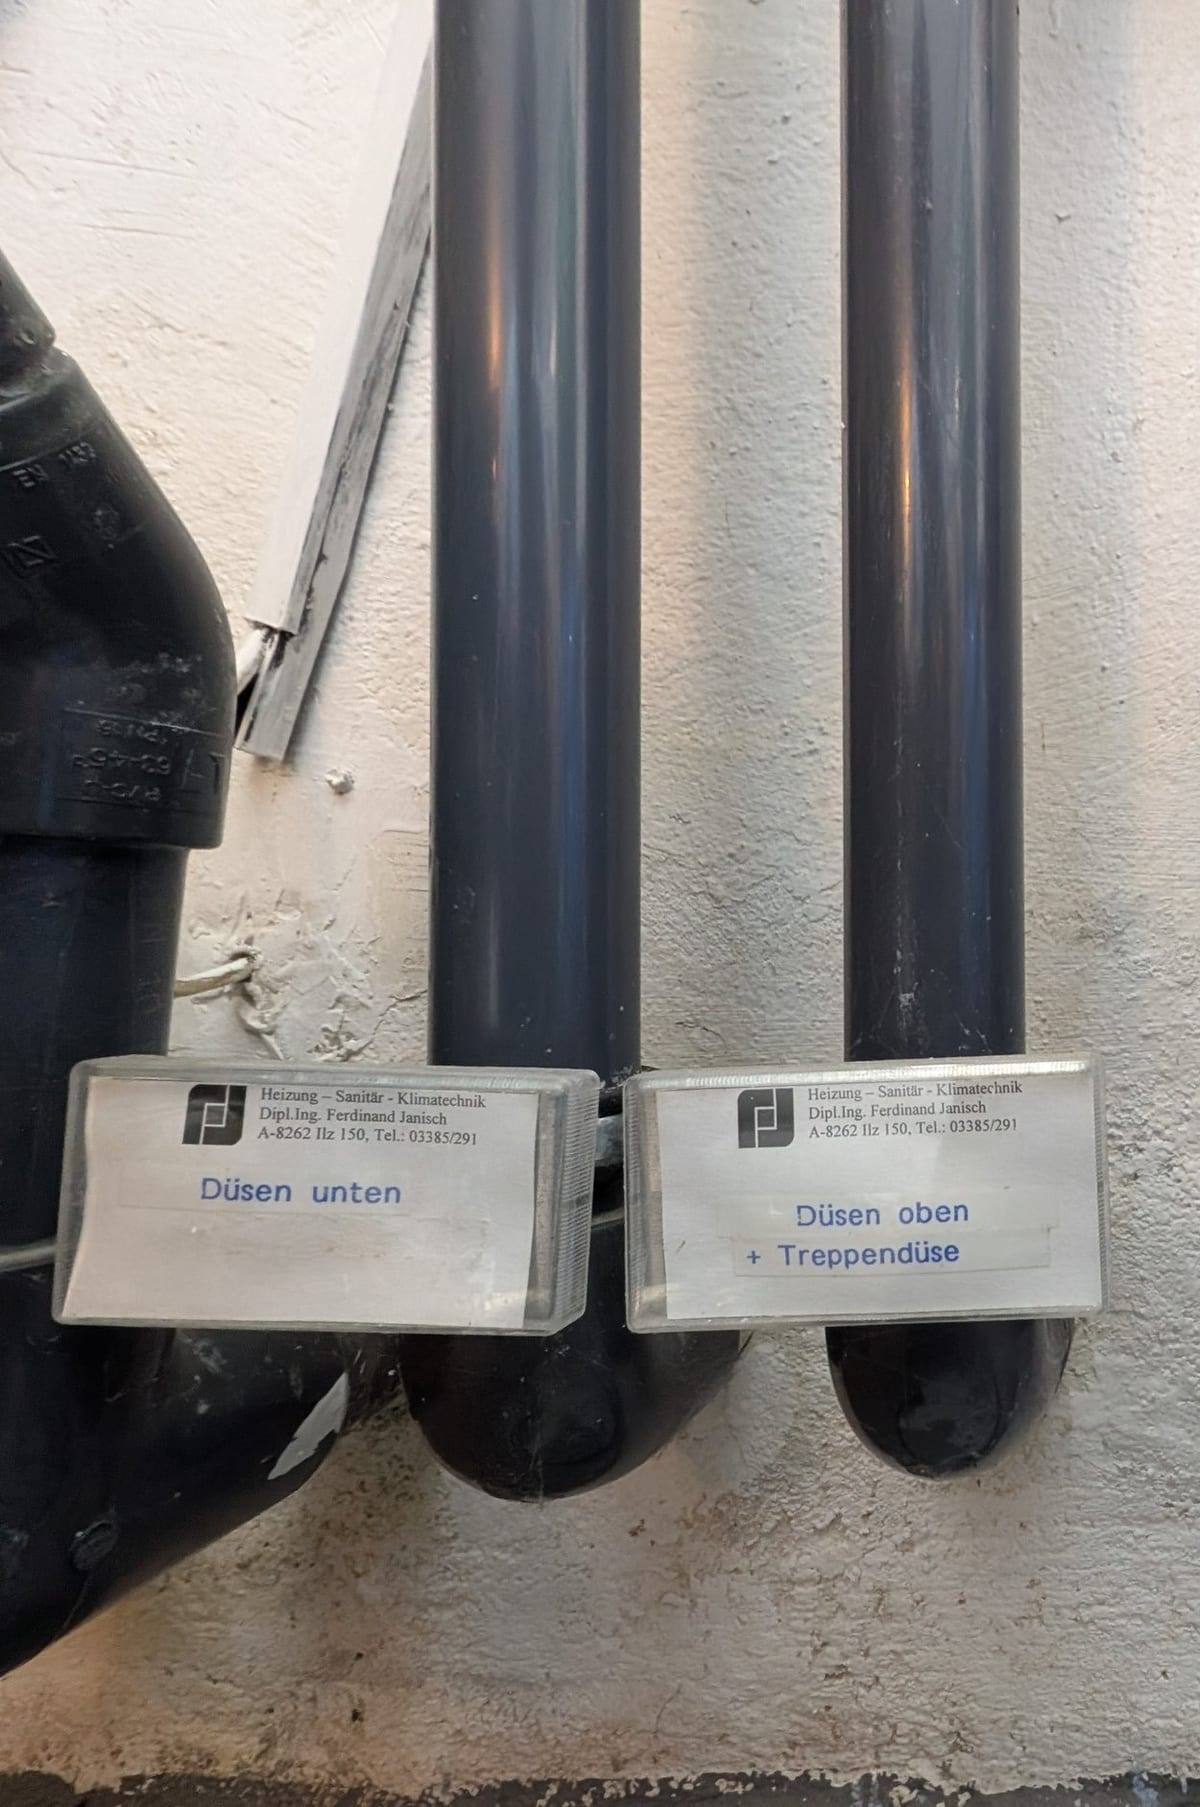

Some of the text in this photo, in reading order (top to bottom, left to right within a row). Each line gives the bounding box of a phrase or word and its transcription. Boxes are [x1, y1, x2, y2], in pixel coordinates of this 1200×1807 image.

[261, 1088, 318, 1104] Heizung
[336, 1091, 384, 1103] Sanitär
[398, 1092, 486, 1108] Klimatechnik
[808, 1088, 862, 1101] Heizung
[879, 1085, 924, 1098] Sanitär
[937, 1081, 1023, 1096] Klimatechnik
[259, 1107, 446, 1125] Dipl.Ing. Ferdinand Janisch
[809, 1101, 986, 1122] Dipl.Ing. Ferdinand Janisch
[257, 1127, 311, 1139] A-8262
[316, 1128, 334, 1140] Ilz
[375, 1129, 404, 1141] Tel.:
[409, 1130, 477, 1144] 03385/291
[809, 1125, 858, 1138] A-8262
[862, 1124, 879, 1136] Ilz
[916, 1121, 945, 1134] Tel.:
[950, 1118, 1017, 1133] 03385/291
[200, 1176, 402, 1204] Düsen unten
[796, 1201, 969, 1227] Düsen oben
[746, 1240, 960, 1269] + Treppendüse
